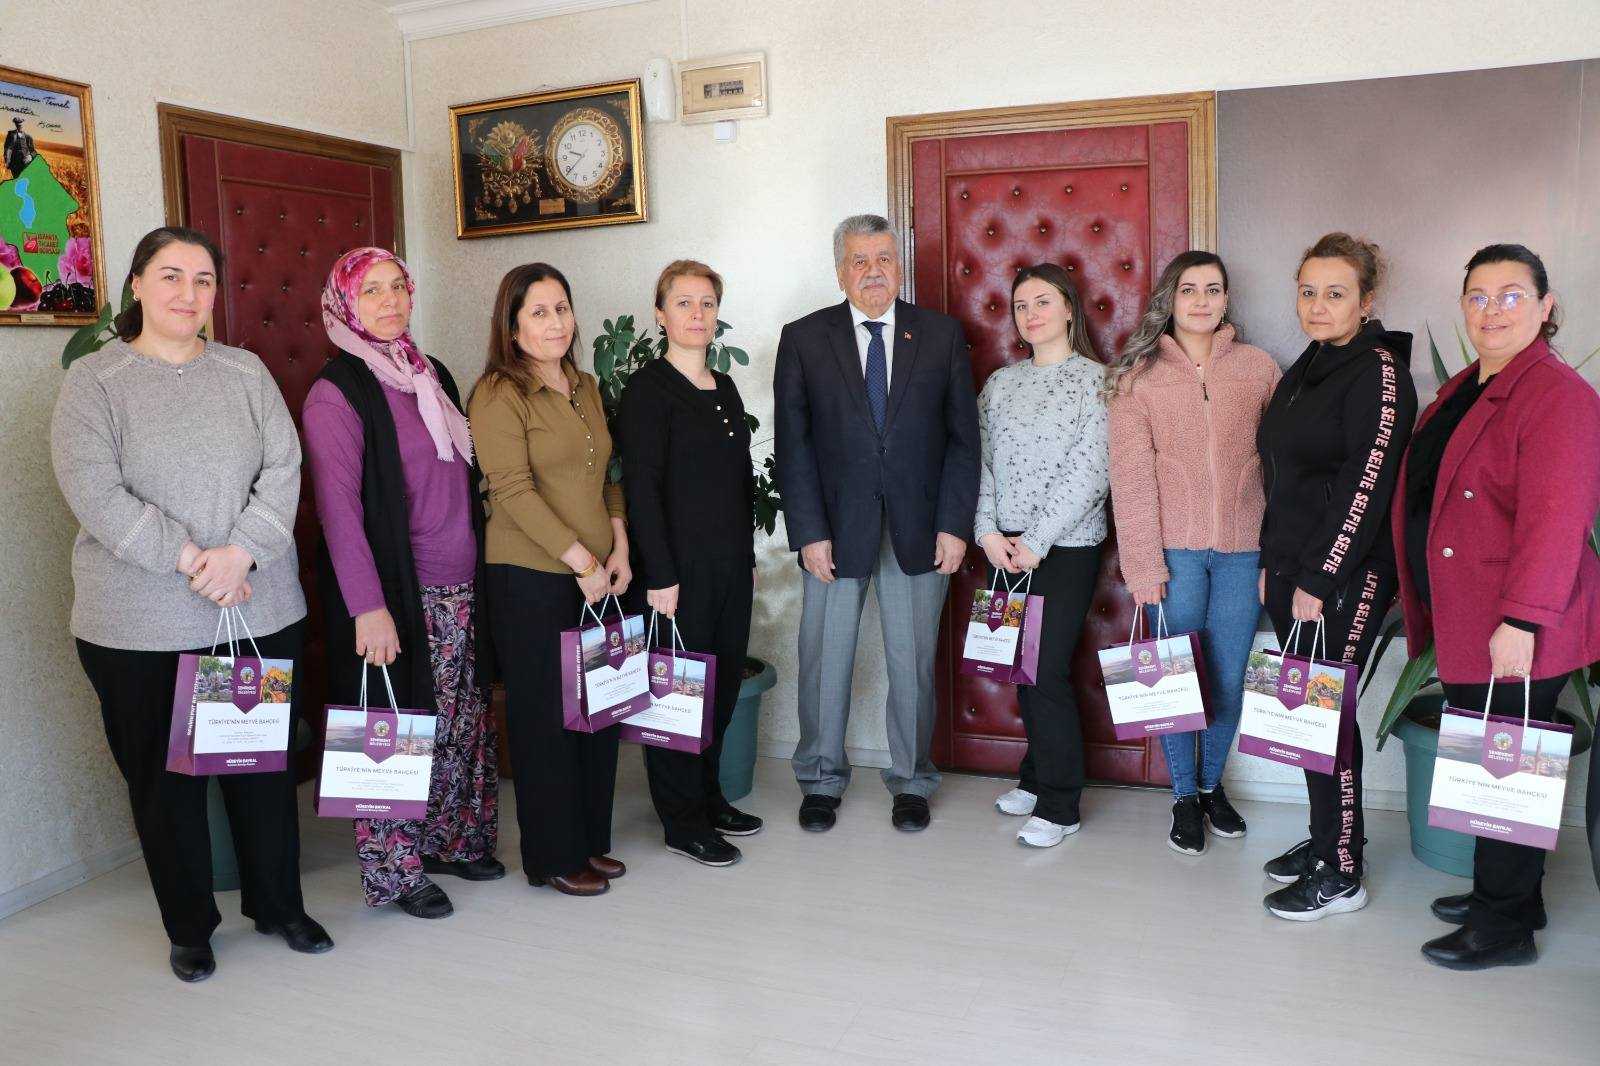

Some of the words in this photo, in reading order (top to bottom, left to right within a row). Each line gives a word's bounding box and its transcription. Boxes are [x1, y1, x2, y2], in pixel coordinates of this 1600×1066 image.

[1382, 364, 1396, 402] SELFIE
[1375, 406, 1394, 448] SELFIE
[1360, 449, 1385, 490] SELFIE
[1342, 492, 1369, 534] SELFIE
[1323, 533, 1351, 574] SELFIE
[1348, 602, 1370, 641] SELFIE
[1340, 768, 1354, 806] SELFIE
[1338, 810, 1354, 846] SELFIE
